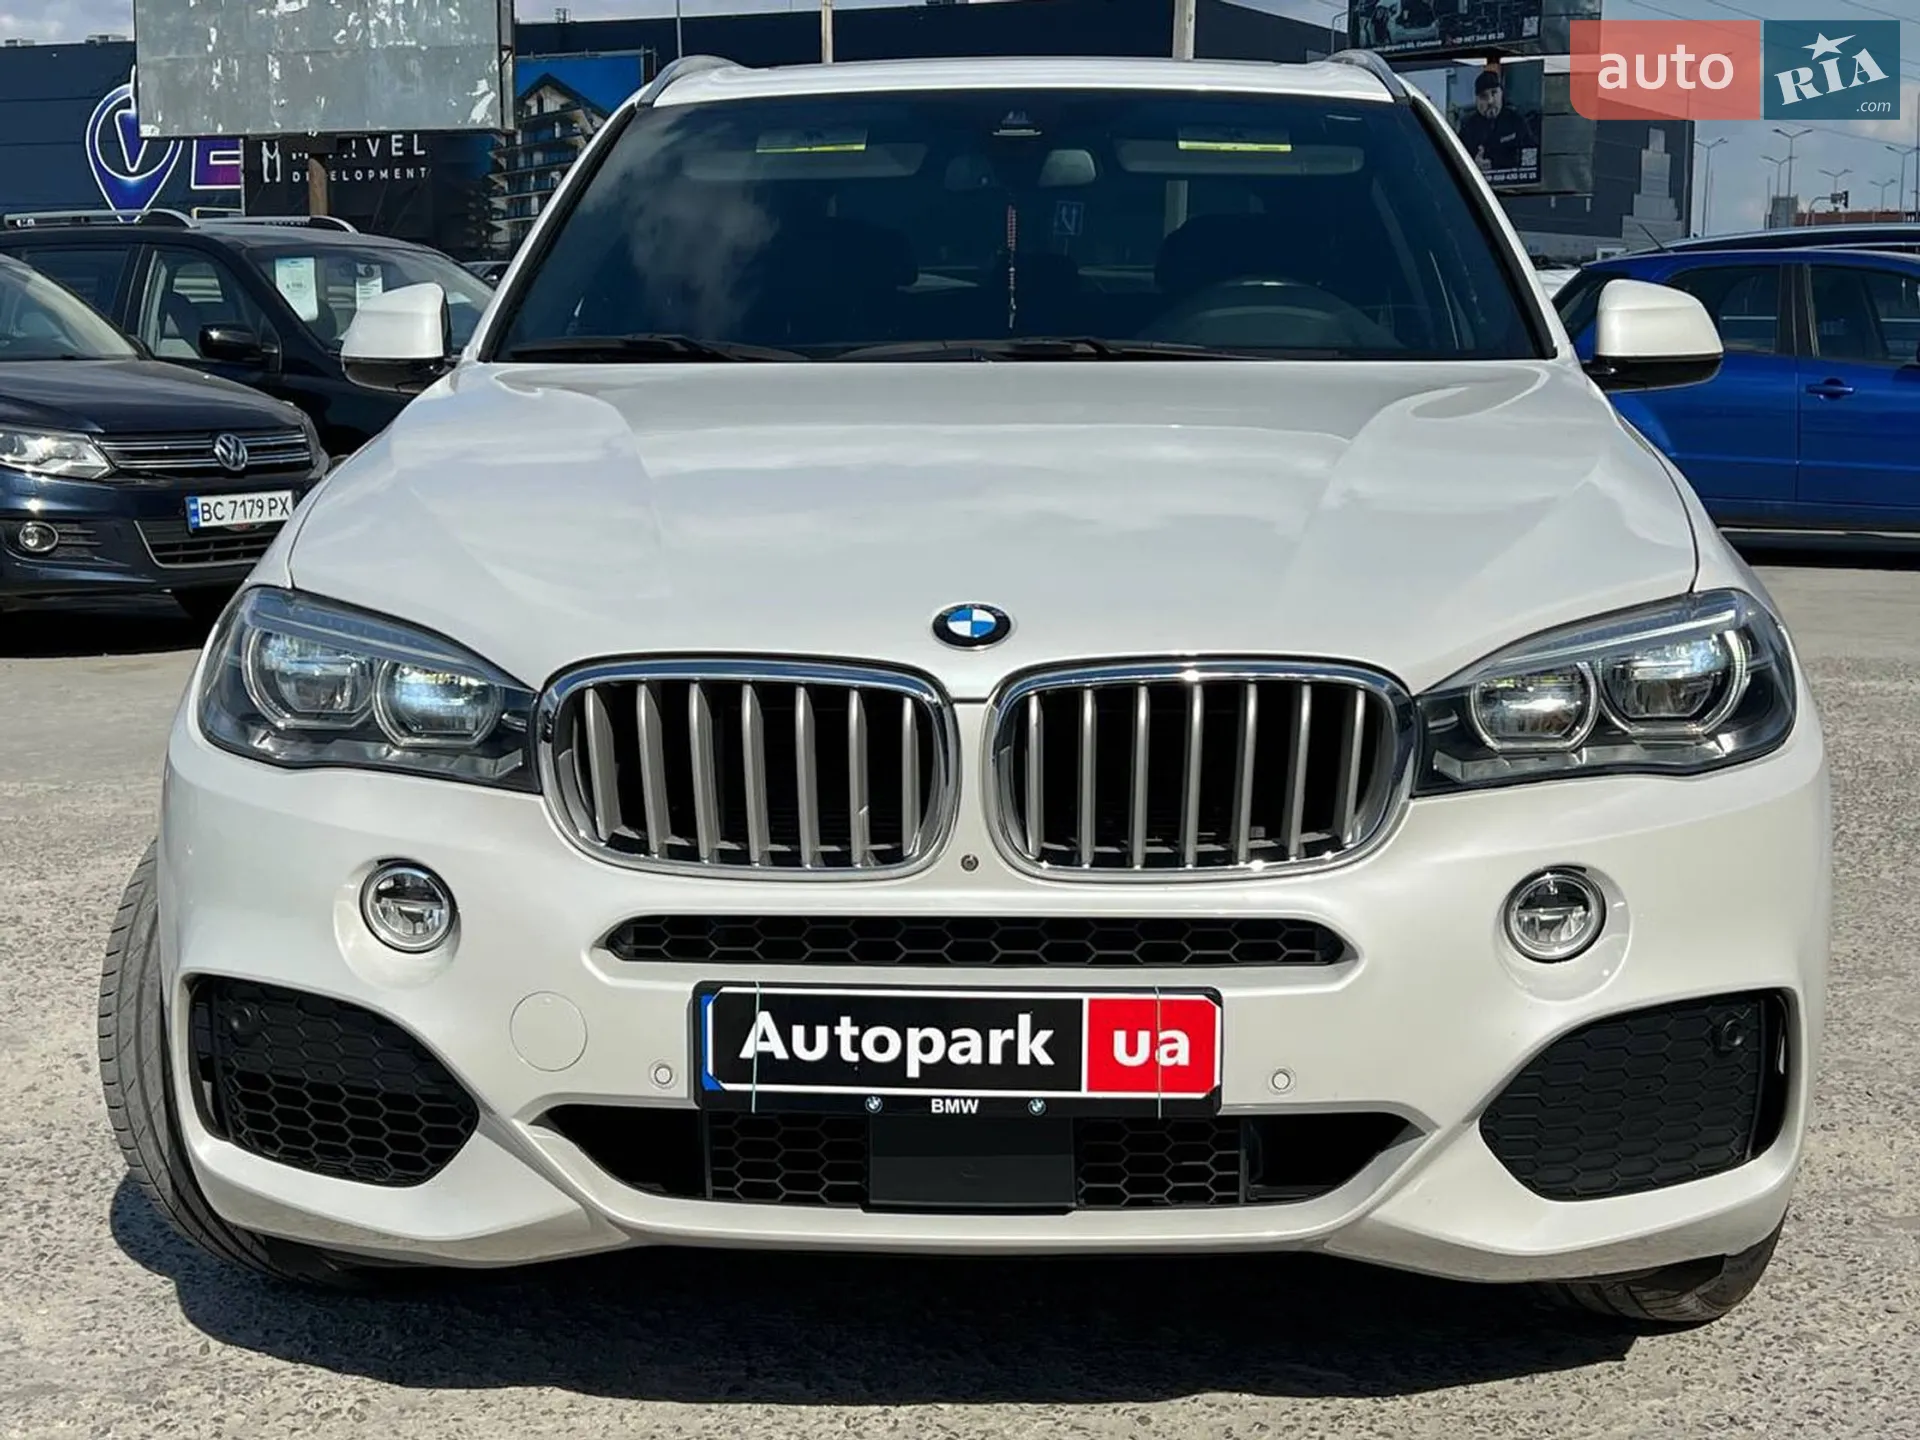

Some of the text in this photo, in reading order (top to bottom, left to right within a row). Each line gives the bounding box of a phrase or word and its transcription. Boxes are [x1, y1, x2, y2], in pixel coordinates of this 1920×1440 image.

[292, 166, 427, 183] DELOPMENT
[201, 502, 226, 522] BC
[228, 498, 265, 520] 7179
[267, 496, 290, 517] PX
[739, 1011, 1189, 1078] Autopark ua
[931, 1098, 979, 1114] BMW
